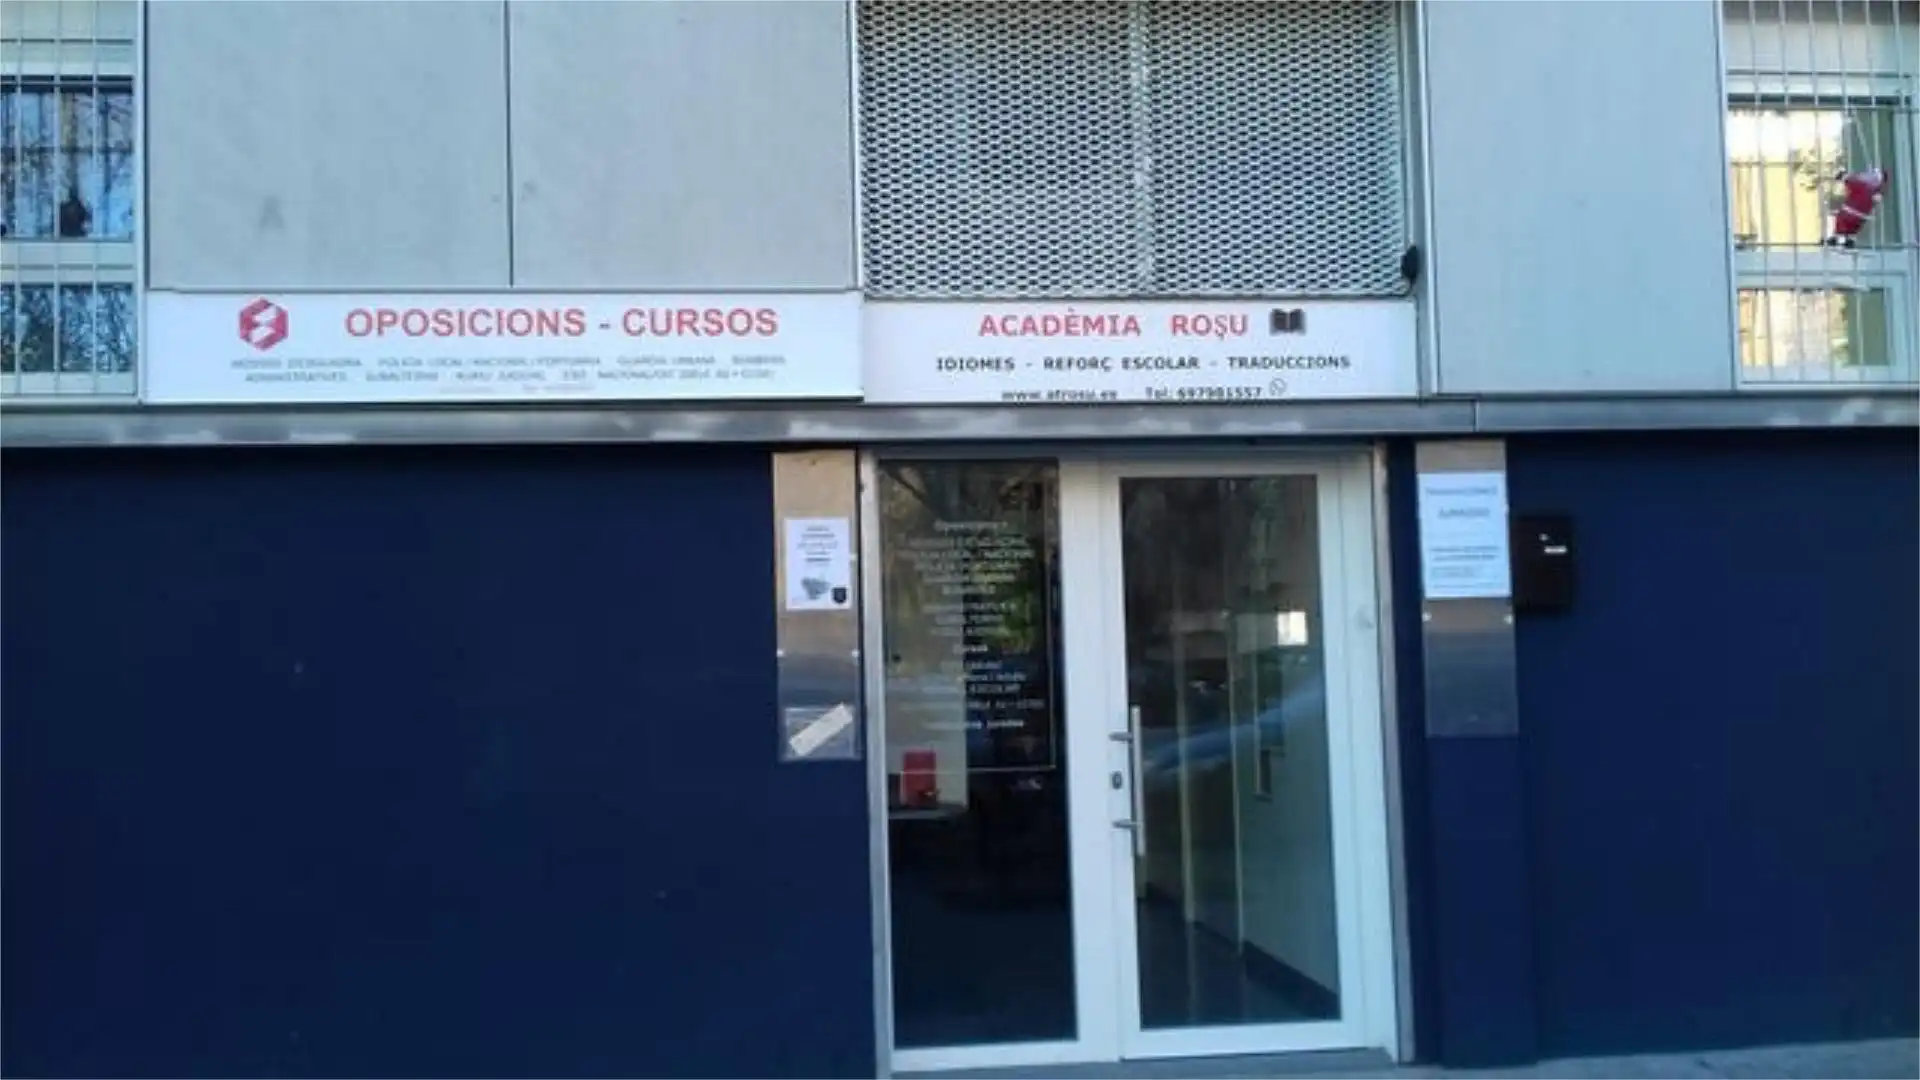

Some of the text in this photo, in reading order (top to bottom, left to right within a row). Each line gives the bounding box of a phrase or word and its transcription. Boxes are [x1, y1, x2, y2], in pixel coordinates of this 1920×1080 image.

[344, 307, 588, 338] OPOSICIONS
[622, 307, 779, 337] CURSOS
[978, 307, 1142, 337] ACADÈMIA
[936, 356, 1015, 371] IDIOMES
[1043, 356, 1112, 373] REFORÇ
[1121, 356, 1201, 370] ESCOLAR
[1226, 355, 1351, 370] TRADUCCIONS
